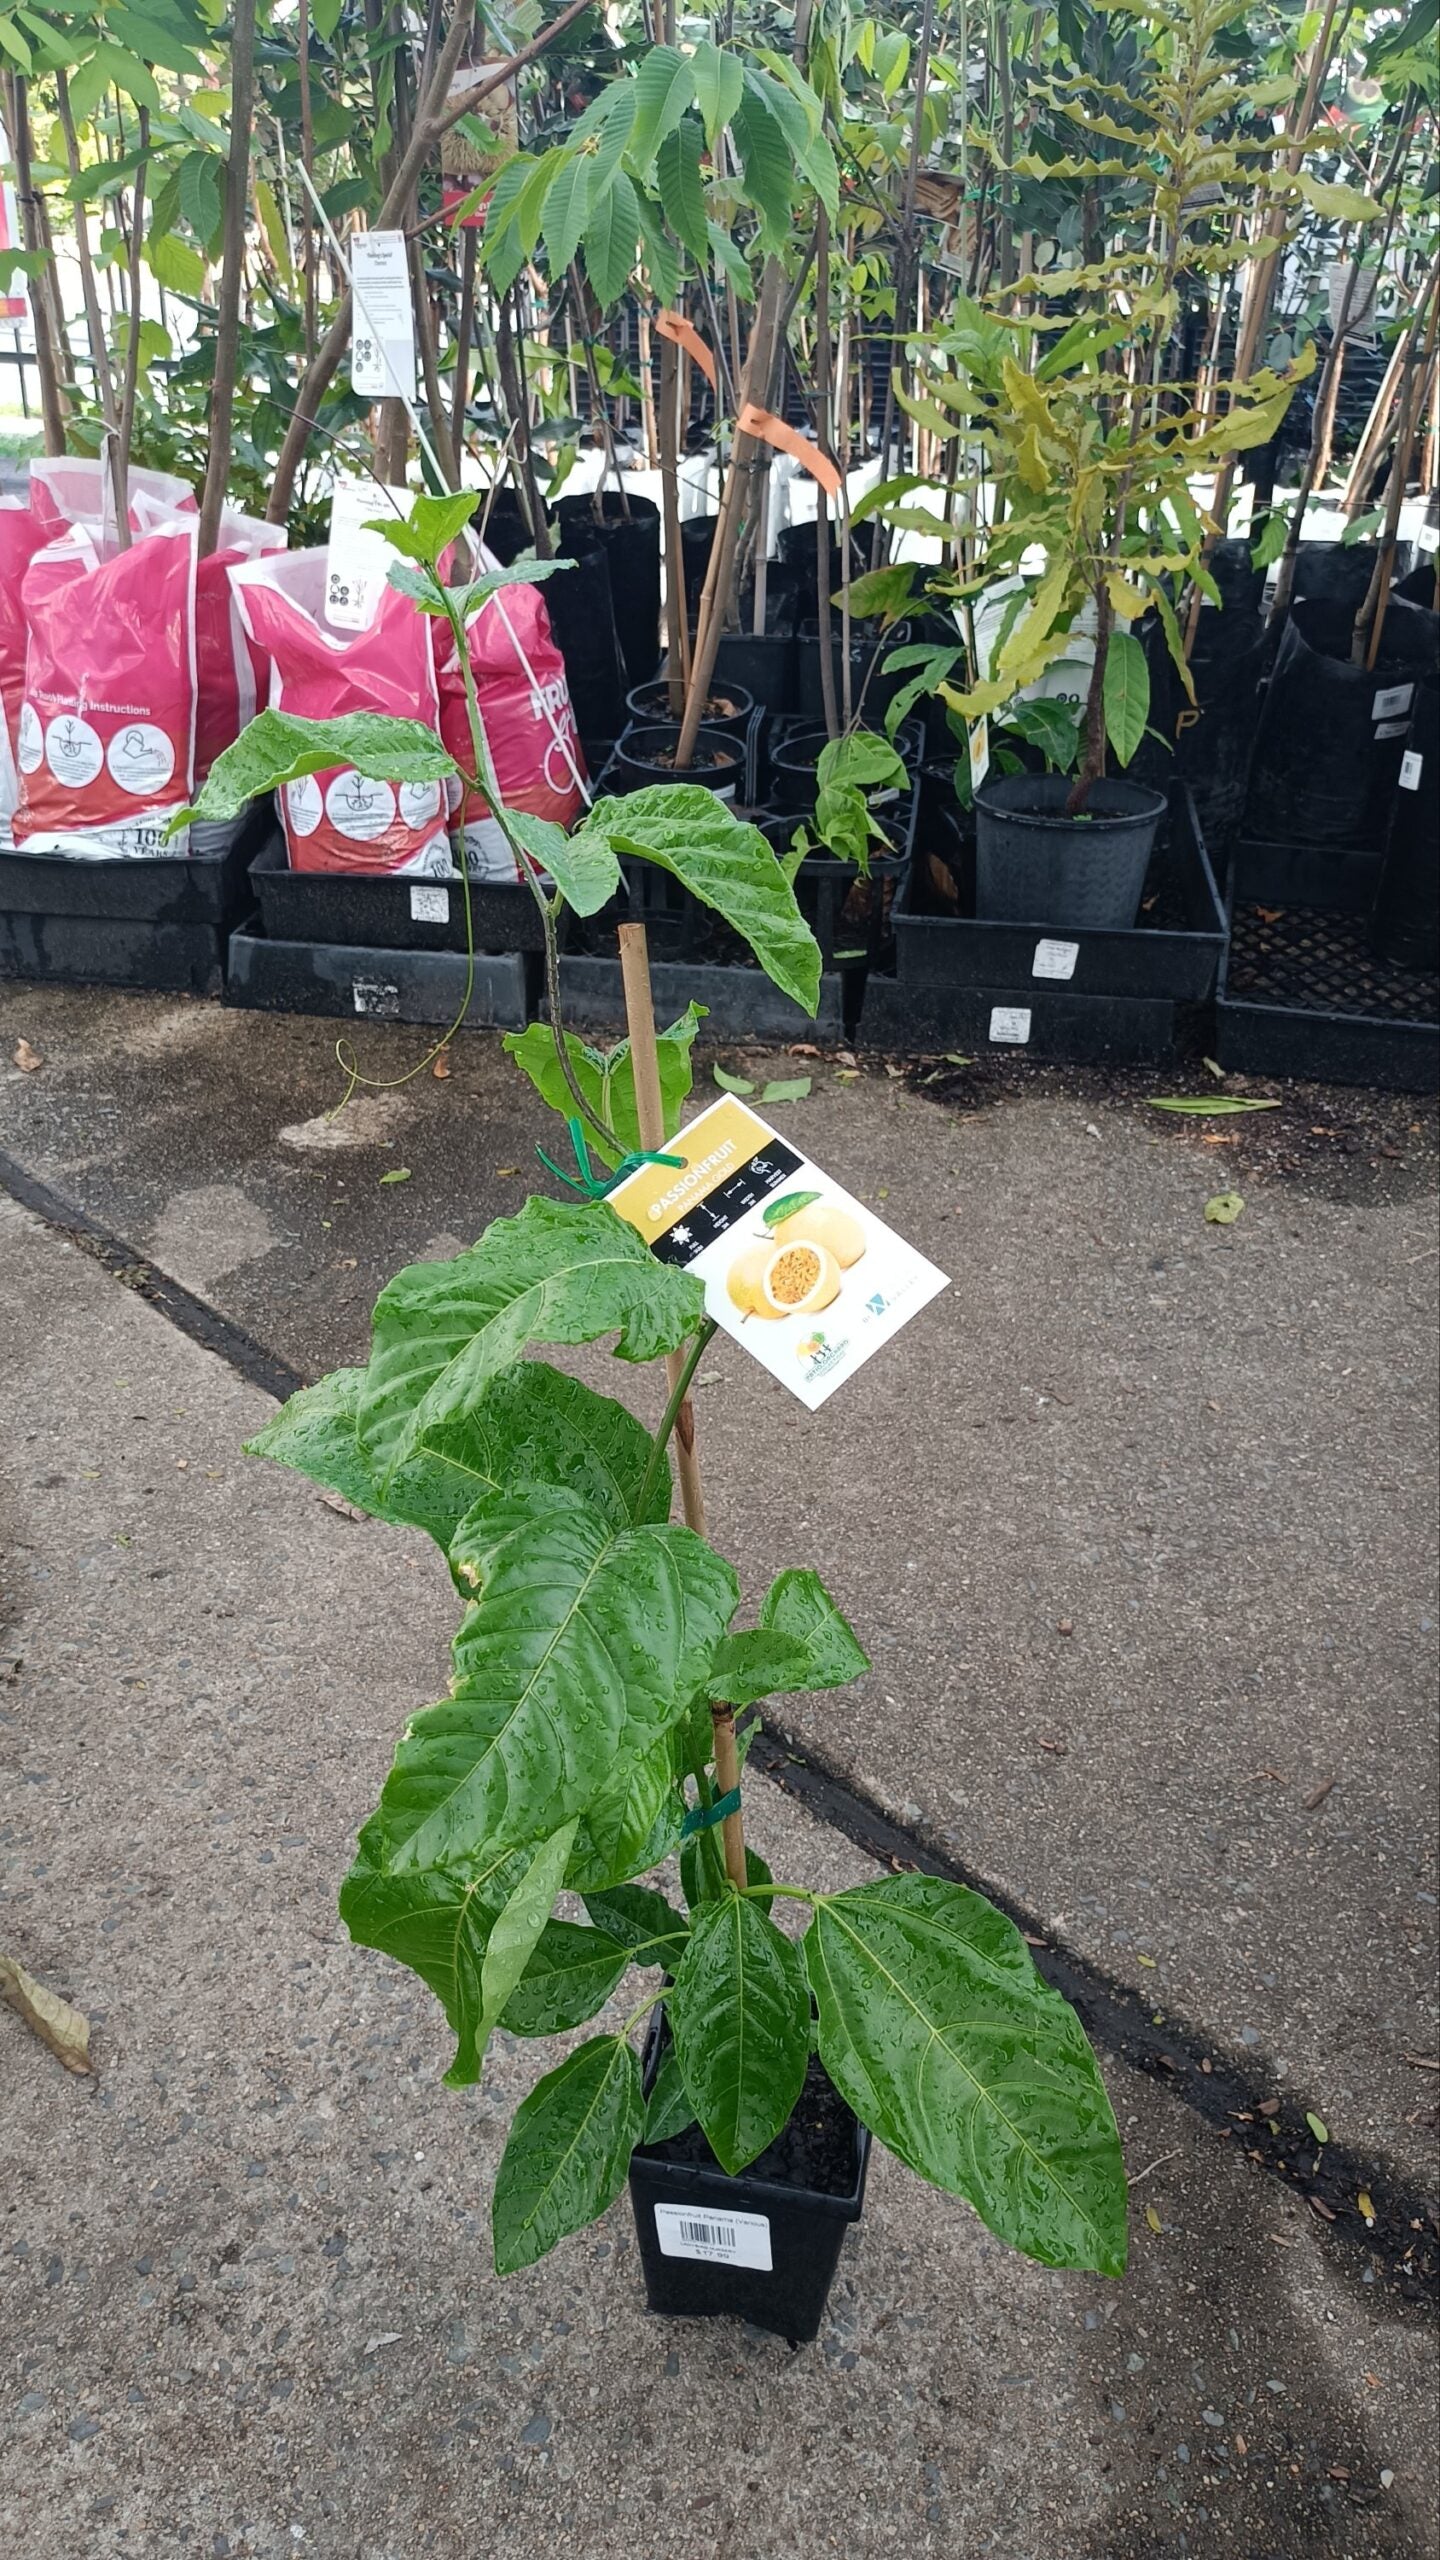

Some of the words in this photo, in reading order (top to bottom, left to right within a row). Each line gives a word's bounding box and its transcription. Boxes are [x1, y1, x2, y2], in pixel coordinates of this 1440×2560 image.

[90, 700, 151, 716] Instructions
[652, 1138, 737, 1214] PASSIONFRUIT
[677, 1180, 713, 1212] PANAMA
[710, 1161, 735, 1184] GOLD
